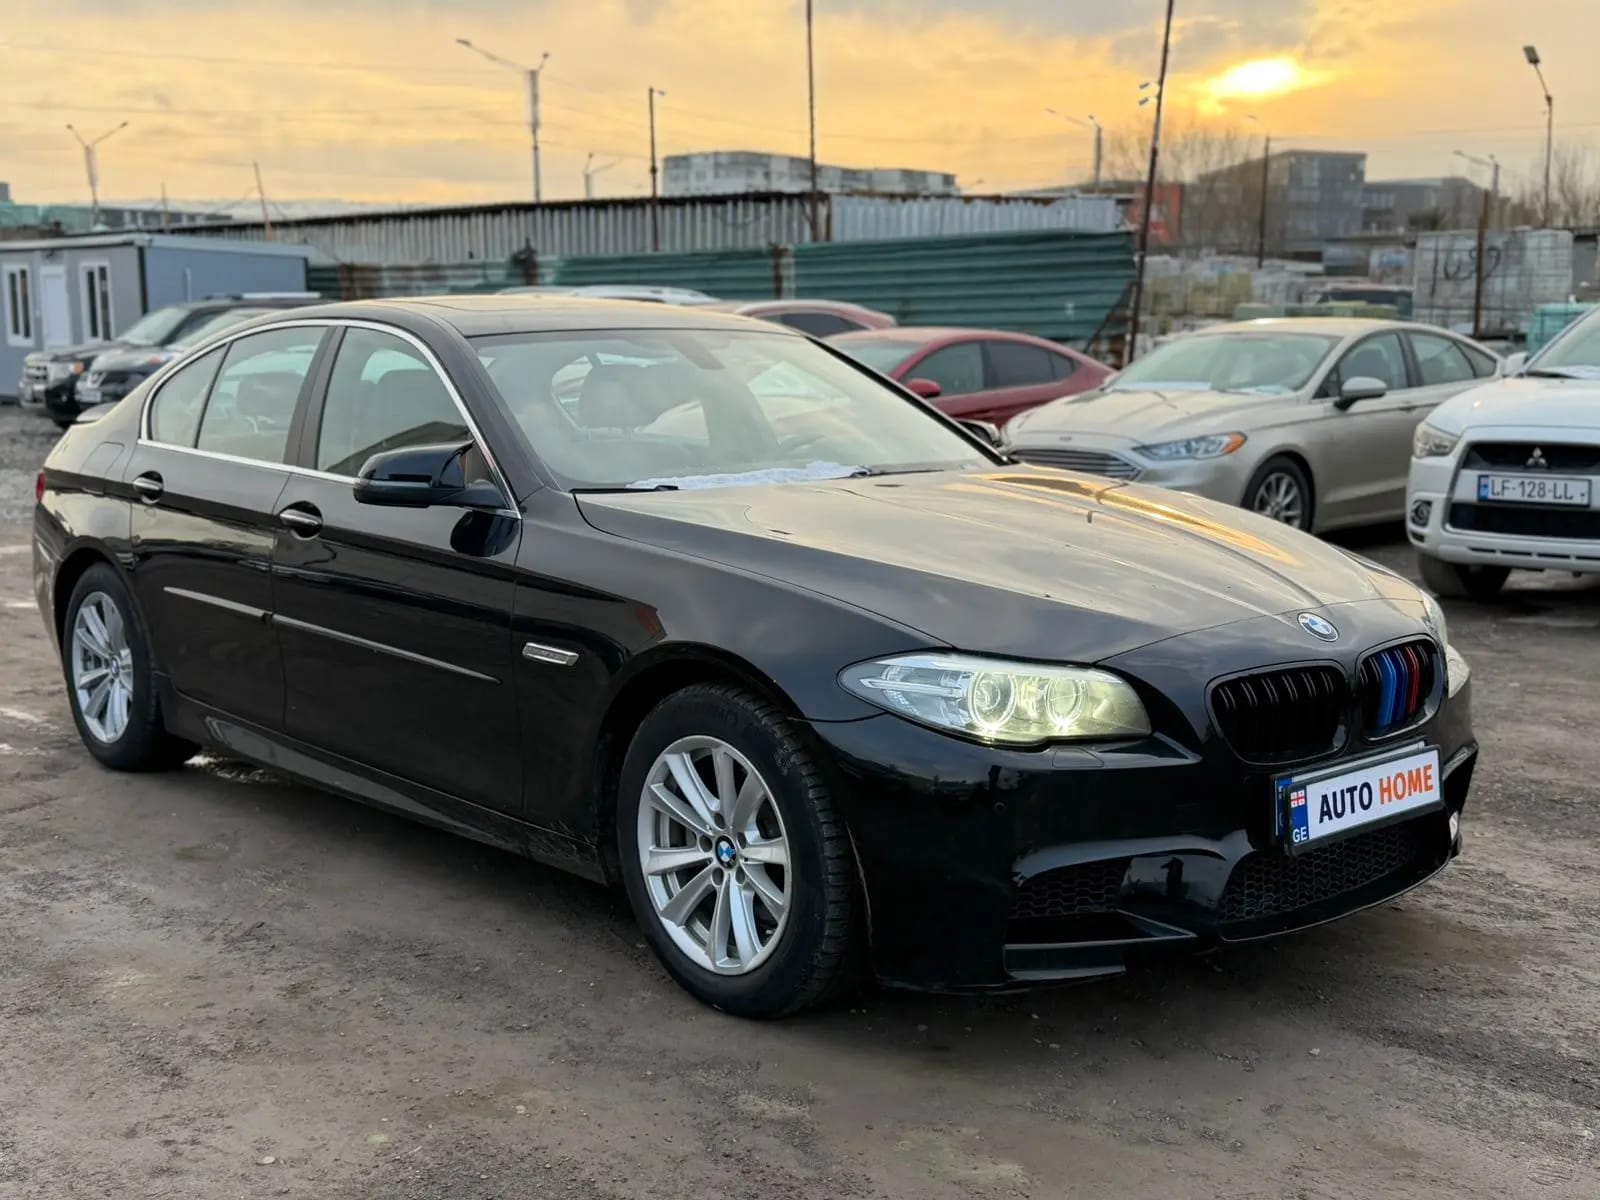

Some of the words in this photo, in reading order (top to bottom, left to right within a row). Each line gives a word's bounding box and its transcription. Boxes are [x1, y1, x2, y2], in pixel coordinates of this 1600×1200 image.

[1491, 479, 1574, 500] LF-128-LL
[1319, 782, 1373, 824] AUTO
[1379, 764, 1434, 805] HOME
[1292, 826, 1308, 843] GE
